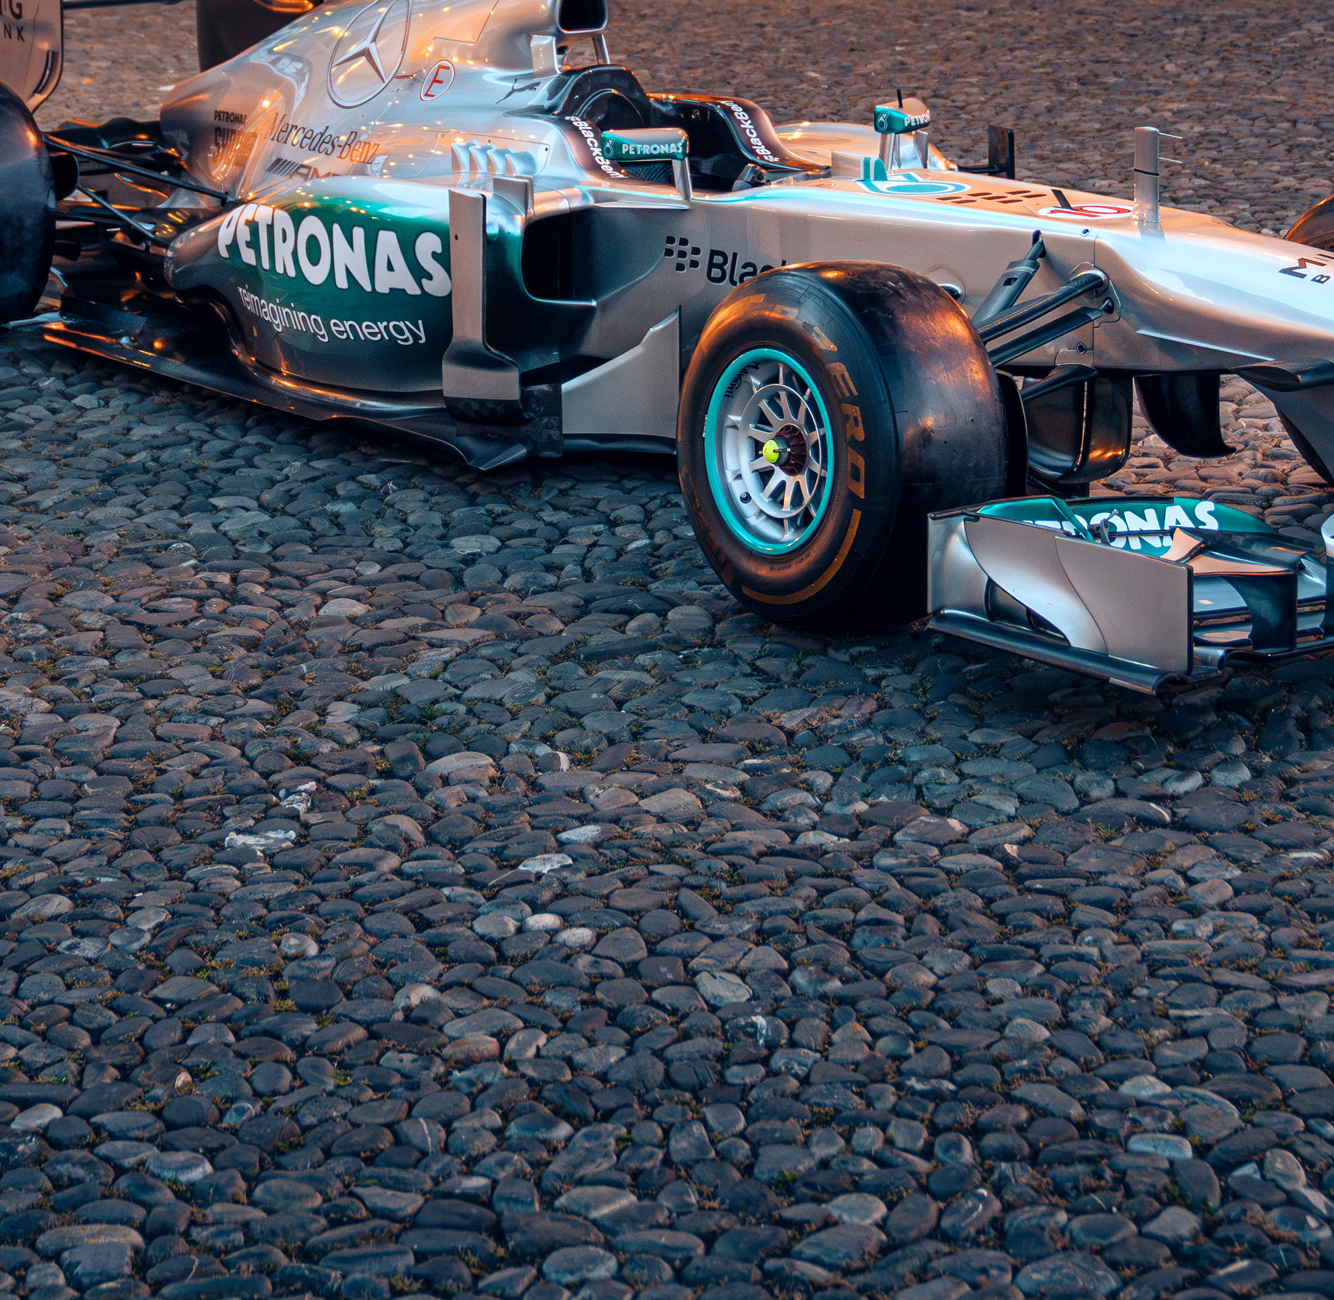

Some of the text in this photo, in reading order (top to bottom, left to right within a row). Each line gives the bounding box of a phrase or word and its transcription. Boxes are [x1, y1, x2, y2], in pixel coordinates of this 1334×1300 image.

[214, 109, 248, 124] PETRONAS
[904, 112, 931, 127] PETRON
[264, 113, 380, 165] Mercedes-Benz
[621, 142, 683, 155] PETRONAS
[218, 202, 452, 298] PETRONAS
[706, 249, 786, 287] Bla
[237, 284, 427, 345] reimagining energy
